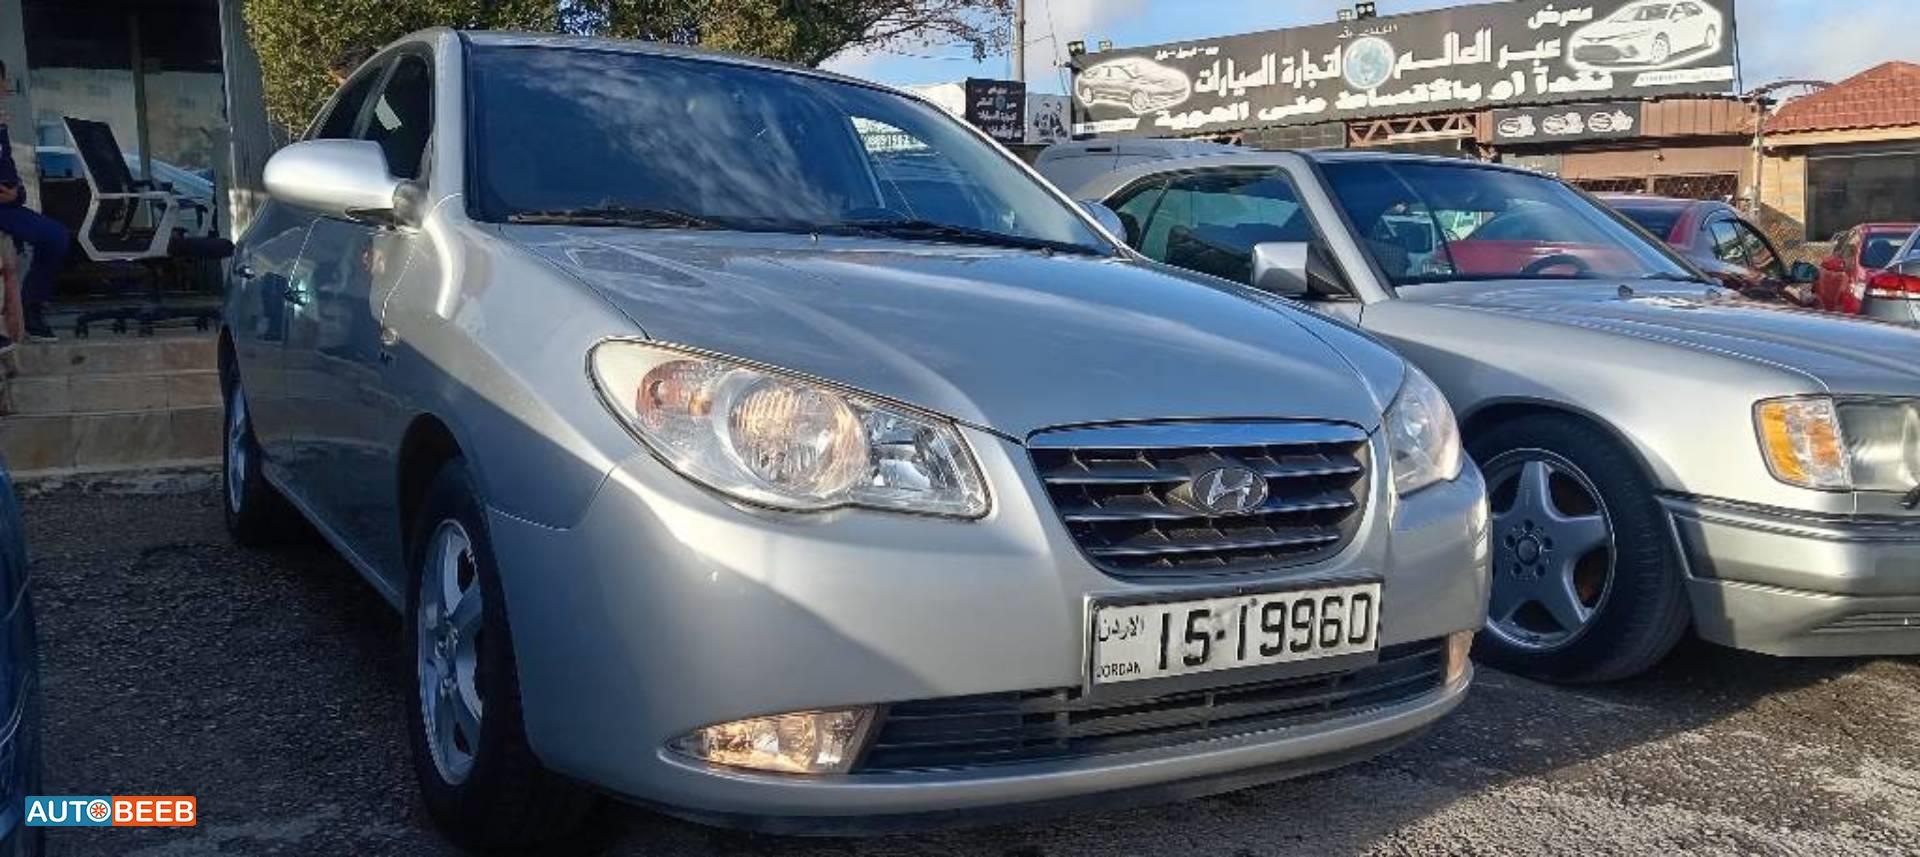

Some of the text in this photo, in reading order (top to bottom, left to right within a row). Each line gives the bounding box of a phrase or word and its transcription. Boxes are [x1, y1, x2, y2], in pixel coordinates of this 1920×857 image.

[1528, 4, 1593, 29] معرض
[1195, 53, 1277, 97] السيارات
[1281, 45, 1342, 88] لتجارة
[1158, 592, 1372, 670] 15-19960
